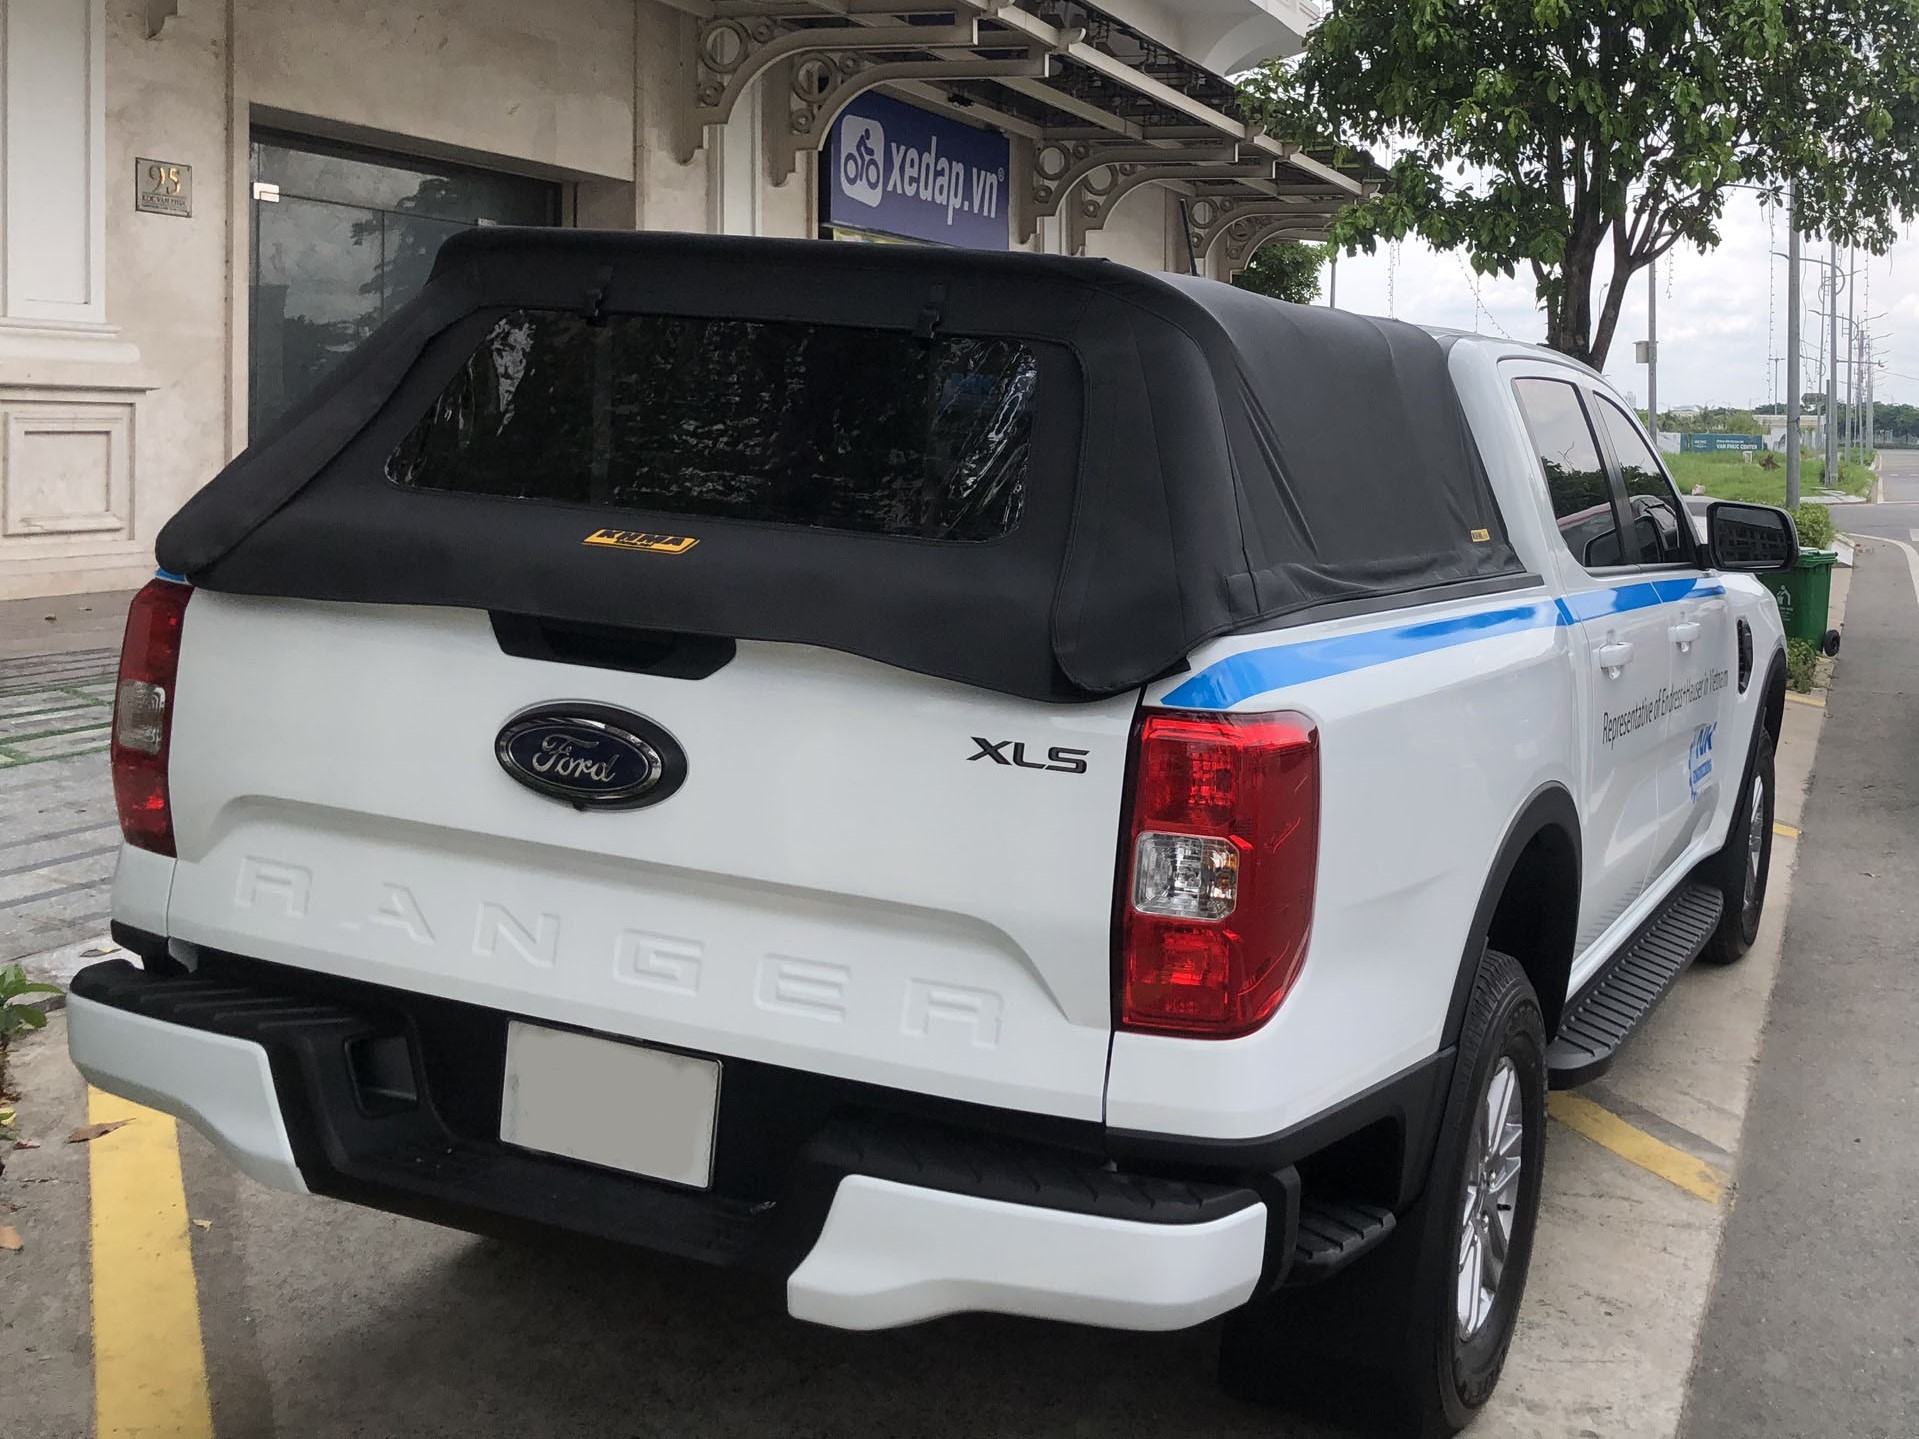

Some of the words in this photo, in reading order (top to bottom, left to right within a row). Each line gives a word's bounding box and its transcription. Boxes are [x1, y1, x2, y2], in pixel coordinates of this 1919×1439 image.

[149, 165, 181, 195] 95
[1602, 696, 1653, 751] Representative
[1653, 688, 1662, 720] of
[532, 733, 620, 782] Ford
[966, 736, 1090, 774] XLS
[231, 853, 1003, 1049] RANGER
